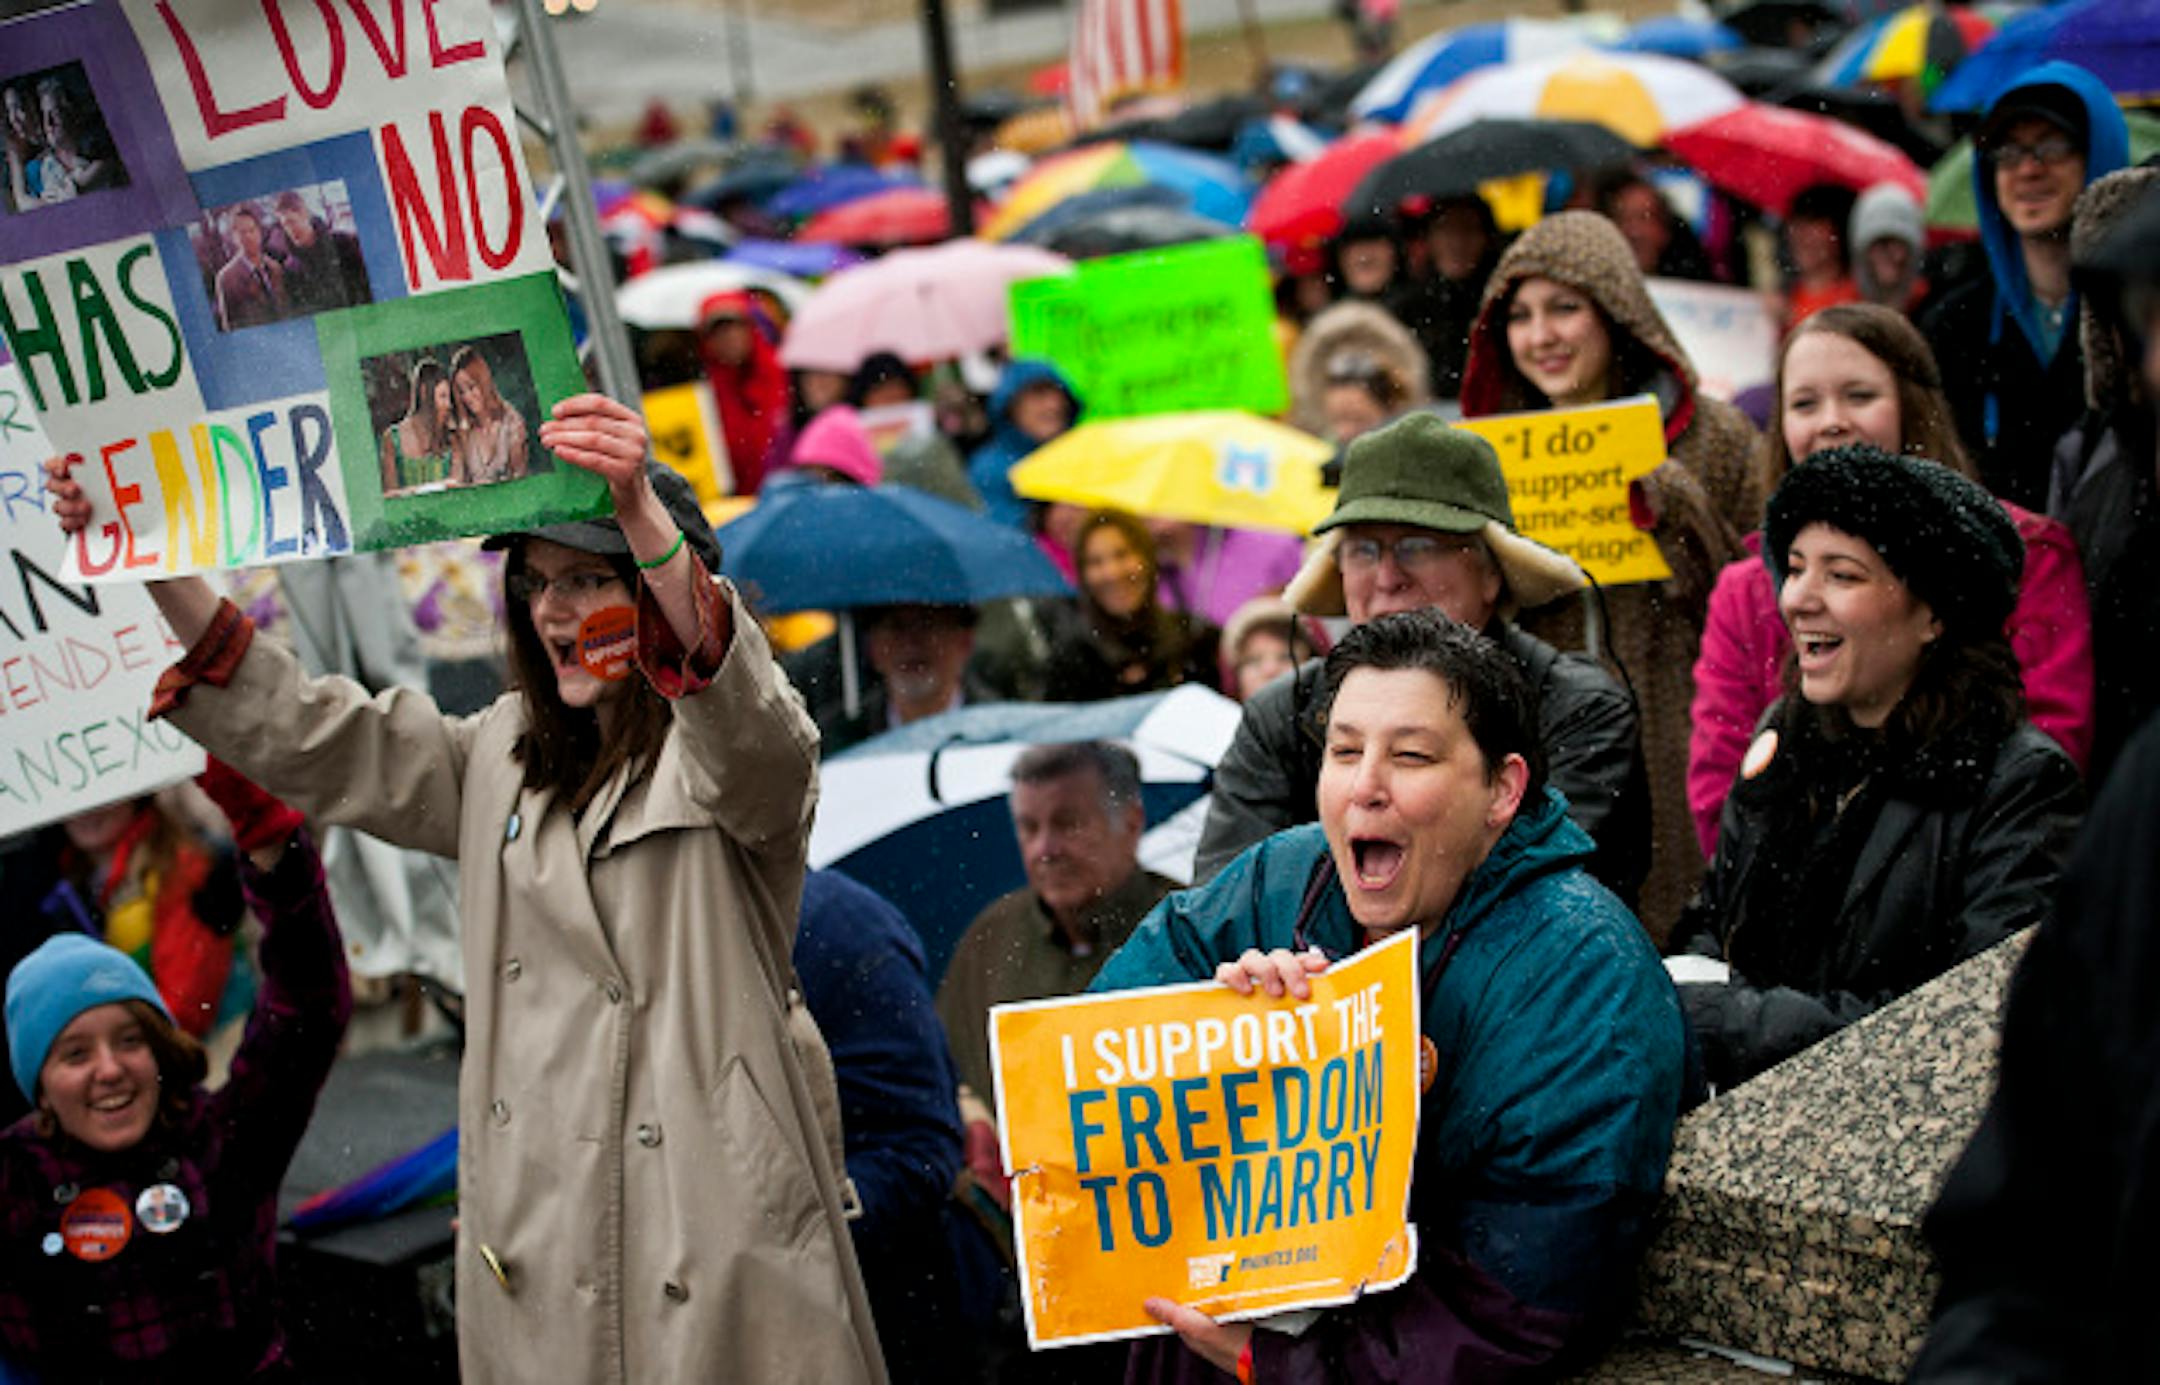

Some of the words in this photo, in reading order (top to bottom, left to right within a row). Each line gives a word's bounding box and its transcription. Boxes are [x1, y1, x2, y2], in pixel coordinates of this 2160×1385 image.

[380, 105, 524, 292] NO
[0, 243, 183, 412] HAS
[64, 403, 351, 578] GENDER
[1060, 1034, 1079, 1089] I
[1094, 1002, 1320, 1086] SUPPORT
[1332, 982, 1384, 1054] THE
[1066, 1041, 1384, 1174] FREEDOM
[1079, 1171, 1174, 1252] TO
[1198, 1129, 1383, 1242] MARRY
